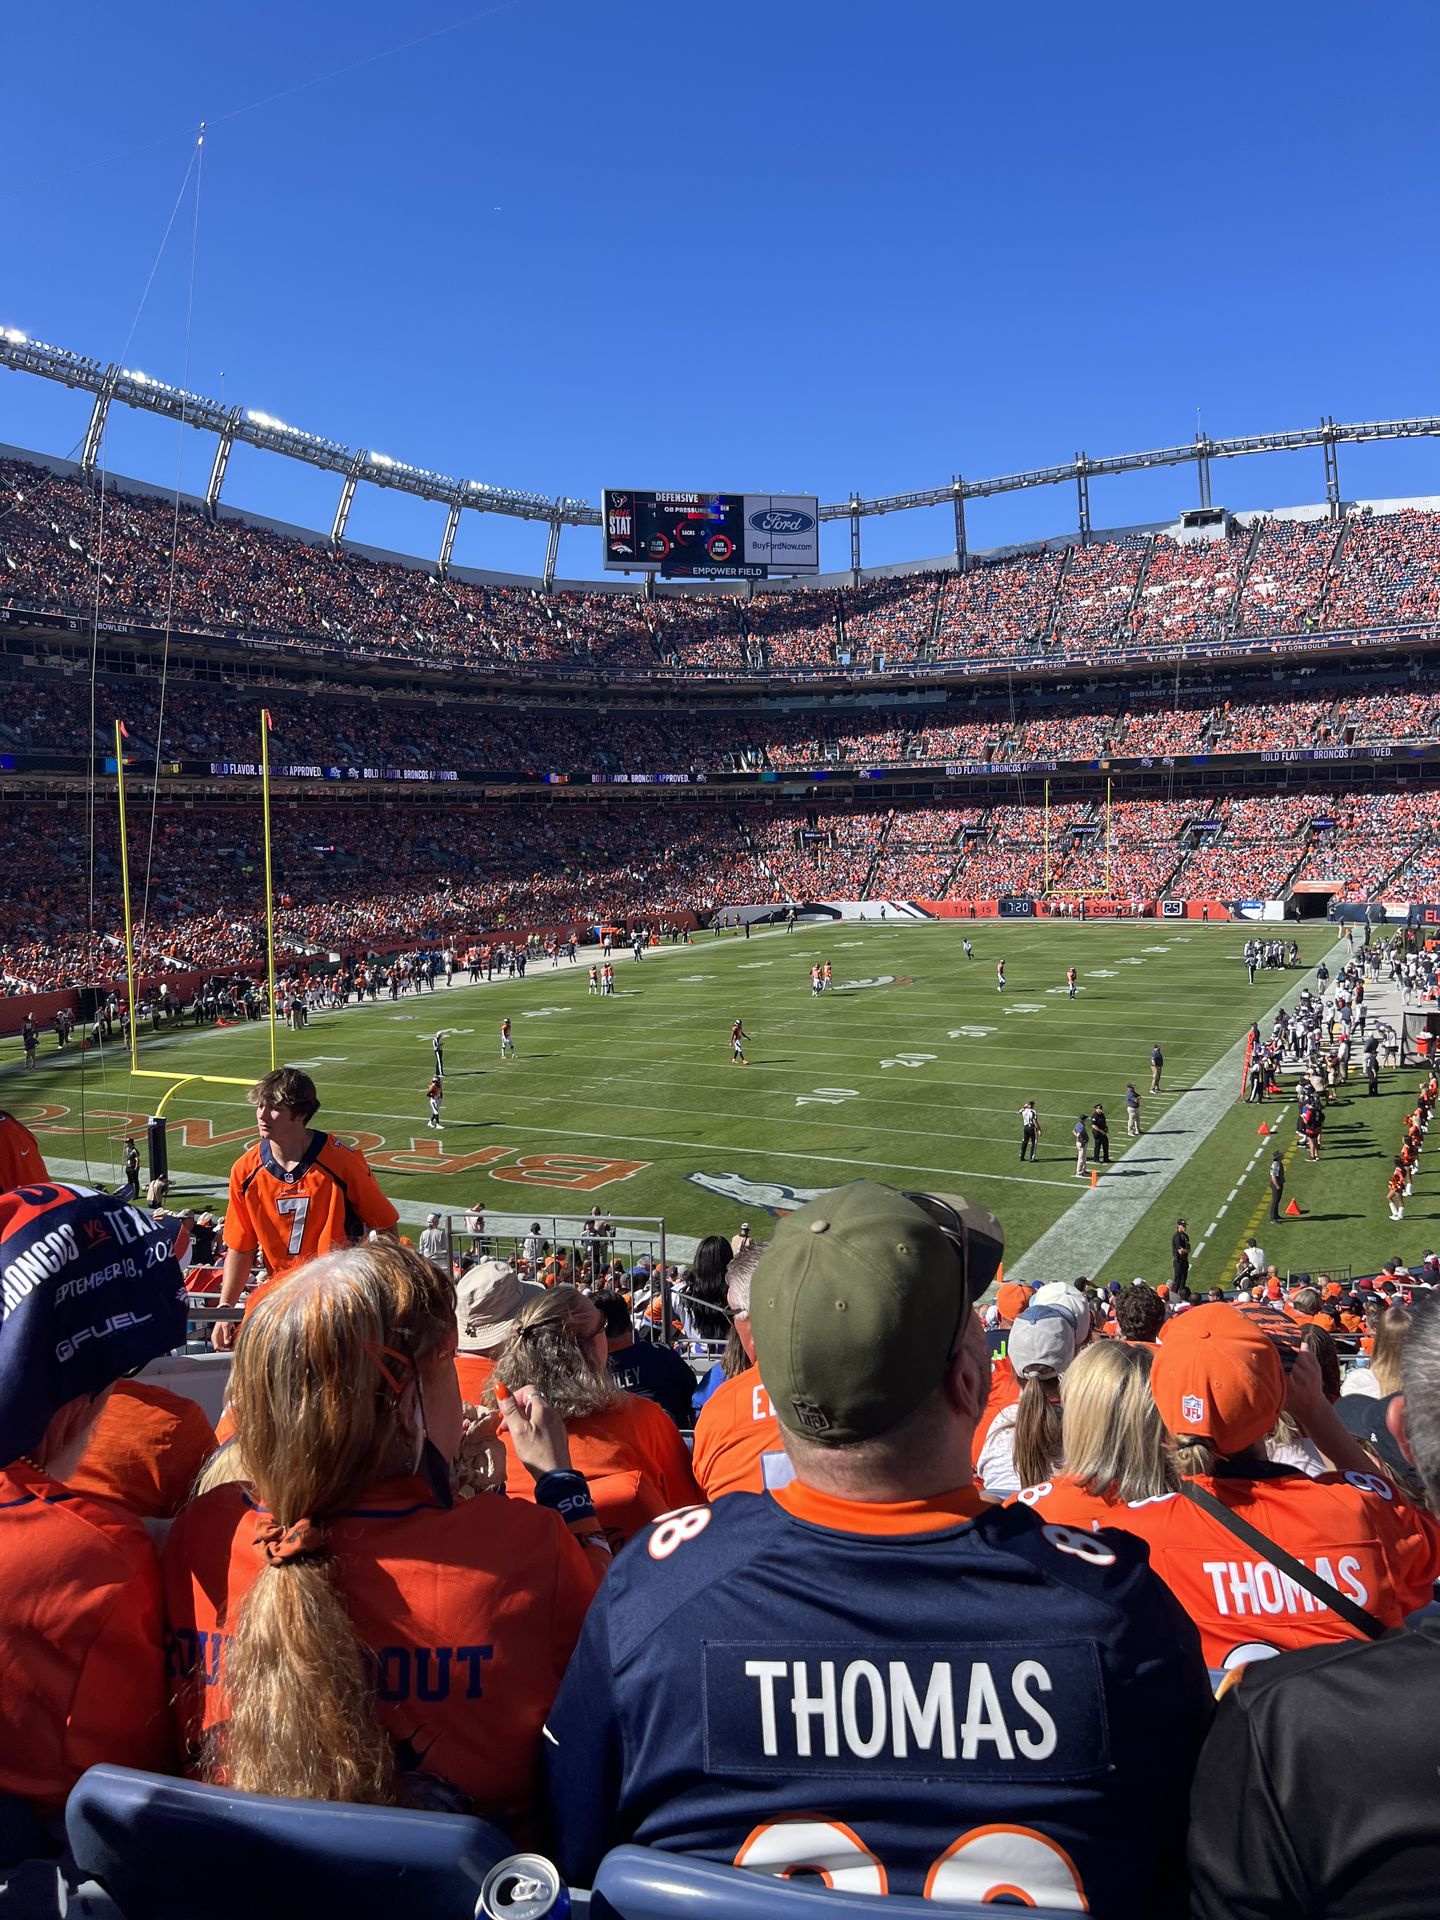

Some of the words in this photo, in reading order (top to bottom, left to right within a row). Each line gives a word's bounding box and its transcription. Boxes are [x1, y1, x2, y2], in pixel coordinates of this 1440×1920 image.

[655, 493, 699, 503] DEFENSIVE
[609, 516, 631, 535] STAT
[762, 511, 802, 530] Ford
[752, 542, 812, 551] BuyFordNow.com
[692, 567, 736, 576] EMPOWER
[738, 568, 762, 576] FIELD
[97, 622, 127, 632] BOWLEN
[1169, 687, 1212, 695] CHAMPIONS
[1261, 753, 1279, 761] BOLD
[1314, 750, 1348, 759] BRONCOS
[211, 763, 228, 774] BOLD
[230, 763, 257, 775] FLAVOR.
[290, 766, 323, 776] APPROVED.
[364, 768, 379, 778] BOLD
[404, 770, 428, 779] BRONCOS
[946, 767, 962, 775] BOLD
[991, 764, 1020, 773] BRONCOS
[631, 774, 657, 783] BRONCOS
[1009, 903, 1029, 913] 7:20
[1165, 904, 1179, 912] 25
[879, 1052, 938, 1069] 20
[795, 1087, 860, 1107] 10
[276, 1196, 310, 1256] 7
[123, 1257, 143, 1279] 18,
[1017, 1482, 1054, 1507] 8
[648, 1505, 713, 1561] 8
[1042, 1524, 1117, 1567] 8
[365, 1644, 494, 1703] OUT
[744, 1659, 1058, 1761] THOMAS
